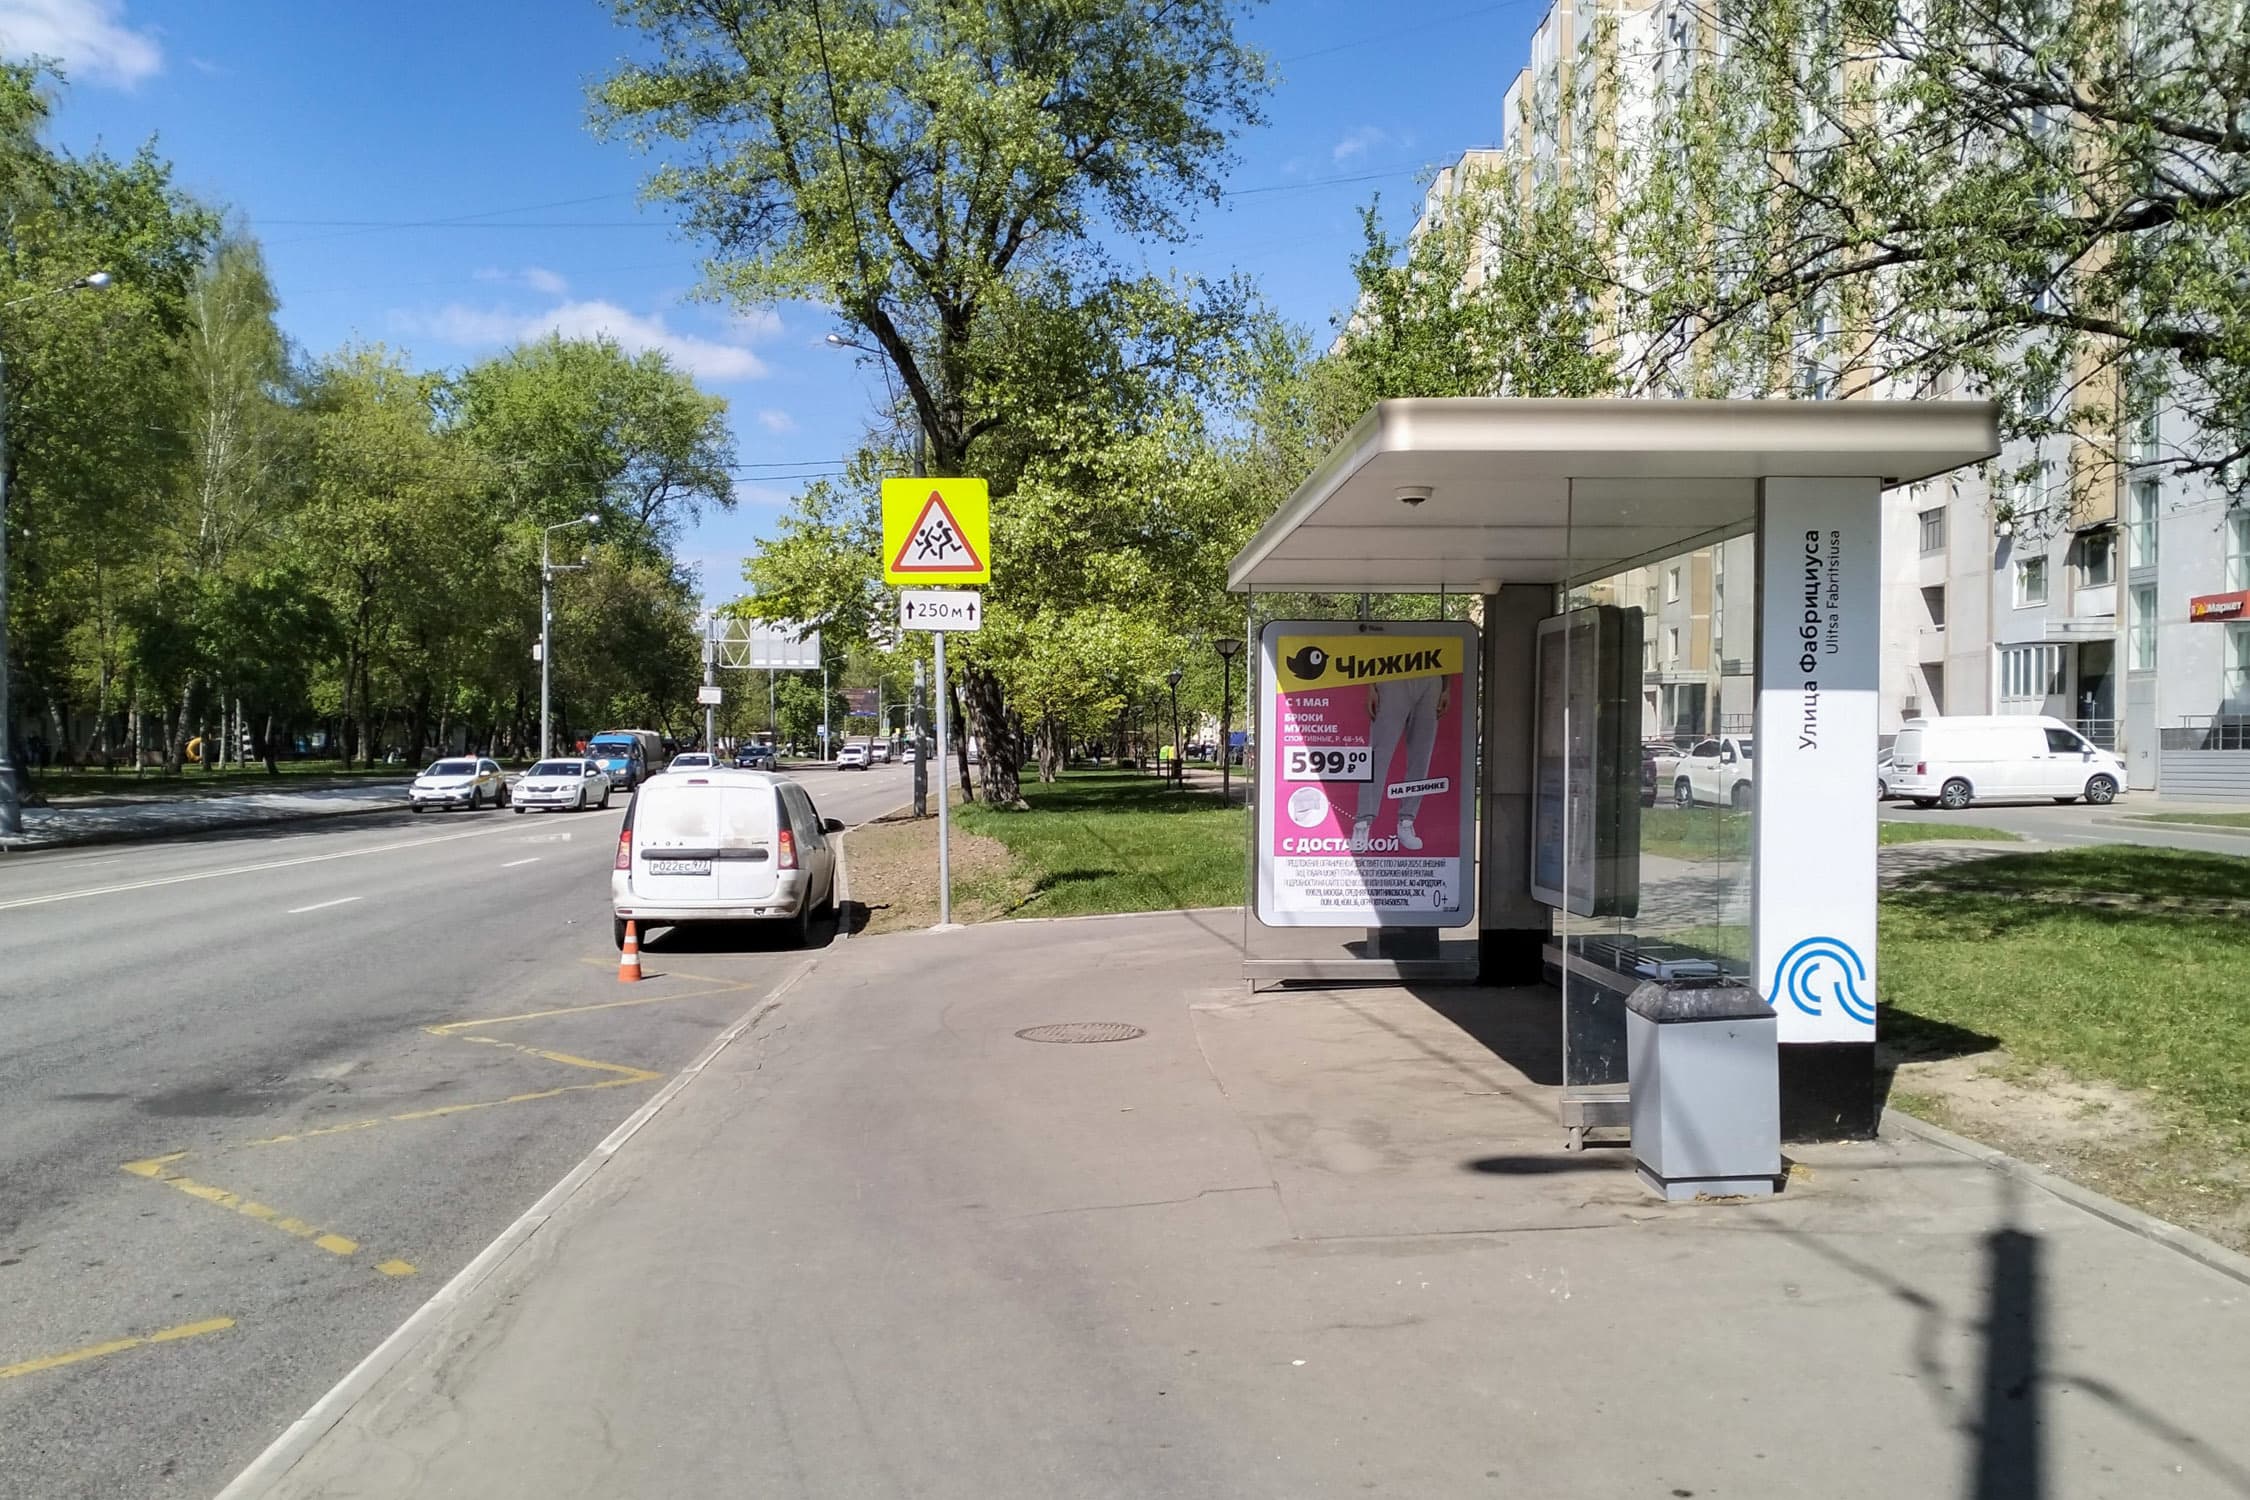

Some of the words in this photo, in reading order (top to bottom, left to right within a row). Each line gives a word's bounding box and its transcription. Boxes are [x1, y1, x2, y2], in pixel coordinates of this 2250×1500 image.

[1826, 529, 1840, 609] Fabritsiusa
[918, 603, 949, 618] 250
[1799, 529, 1823, 674] Фабрициуса
[1825, 613, 1839, 655] Ulitsa
[1285, 698, 1293, 707] С
[1296, 698, 1301, 707] 1
[1303, 698, 1329, 707] МАЯ
[1284, 713, 1324, 722] БРЮКИ
[1799, 680, 1820, 751] Улица
[1284, 724, 1338, 733] МУЖСКИЕ
[1291, 751, 1345, 774] 599
[1390, 785, 1404, 795] НА
[1405, 781, 1446, 793] РЕЗИНКЕ
[1282, 837, 1294, 850] С
[1296, 834, 1399, 853] ДОСТАВКОЙ
[1432, 889, 1449, 908] 0+
